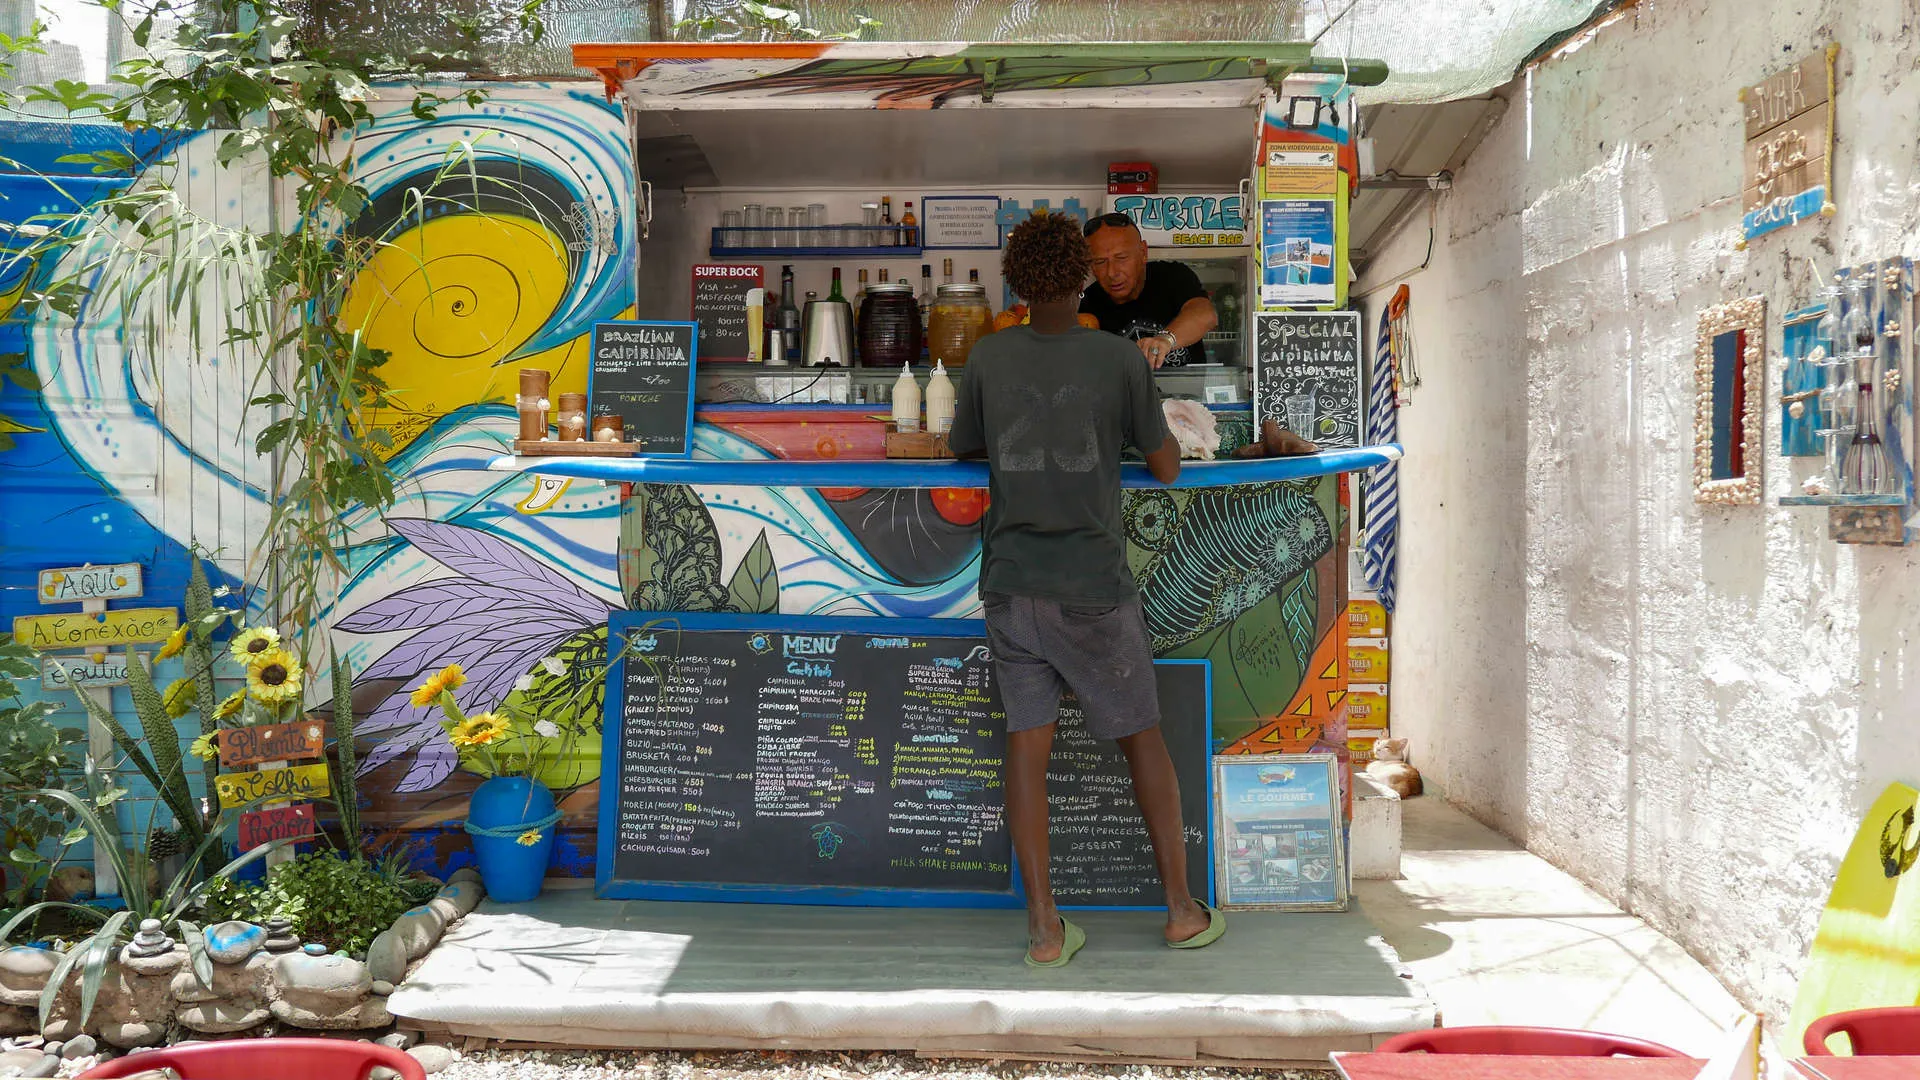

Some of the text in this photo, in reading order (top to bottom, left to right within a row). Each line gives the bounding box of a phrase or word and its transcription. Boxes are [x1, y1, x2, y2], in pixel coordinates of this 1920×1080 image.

[1114, 196, 1244, 231] TURTLE
[1173, 234, 1244, 245] BEACH BAR
[695, 267, 759, 277] SUPER BOCK
[698, 283, 719, 291] VISA
[603, 329, 674, 344] BRAZILIAN
[598, 345, 686, 361] CAIPIRINHA
[1261, 348, 1354, 364] CAIPIRINHA
[32, 622, 50, 644] A
[782, 635, 841, 657] MENU
[675, 656, 709, 664] GAMBAS
[628, 695, 656, 703] POLVO
[626, 718, 656, 728] GAMBAS
[1240, 792, 1316, 802] LE GOURMET
[1071, 841, 1122, 850] DESSERT
[890, 856, 915, 867] MILK
[918, 858, 947, 869] SHAKE
